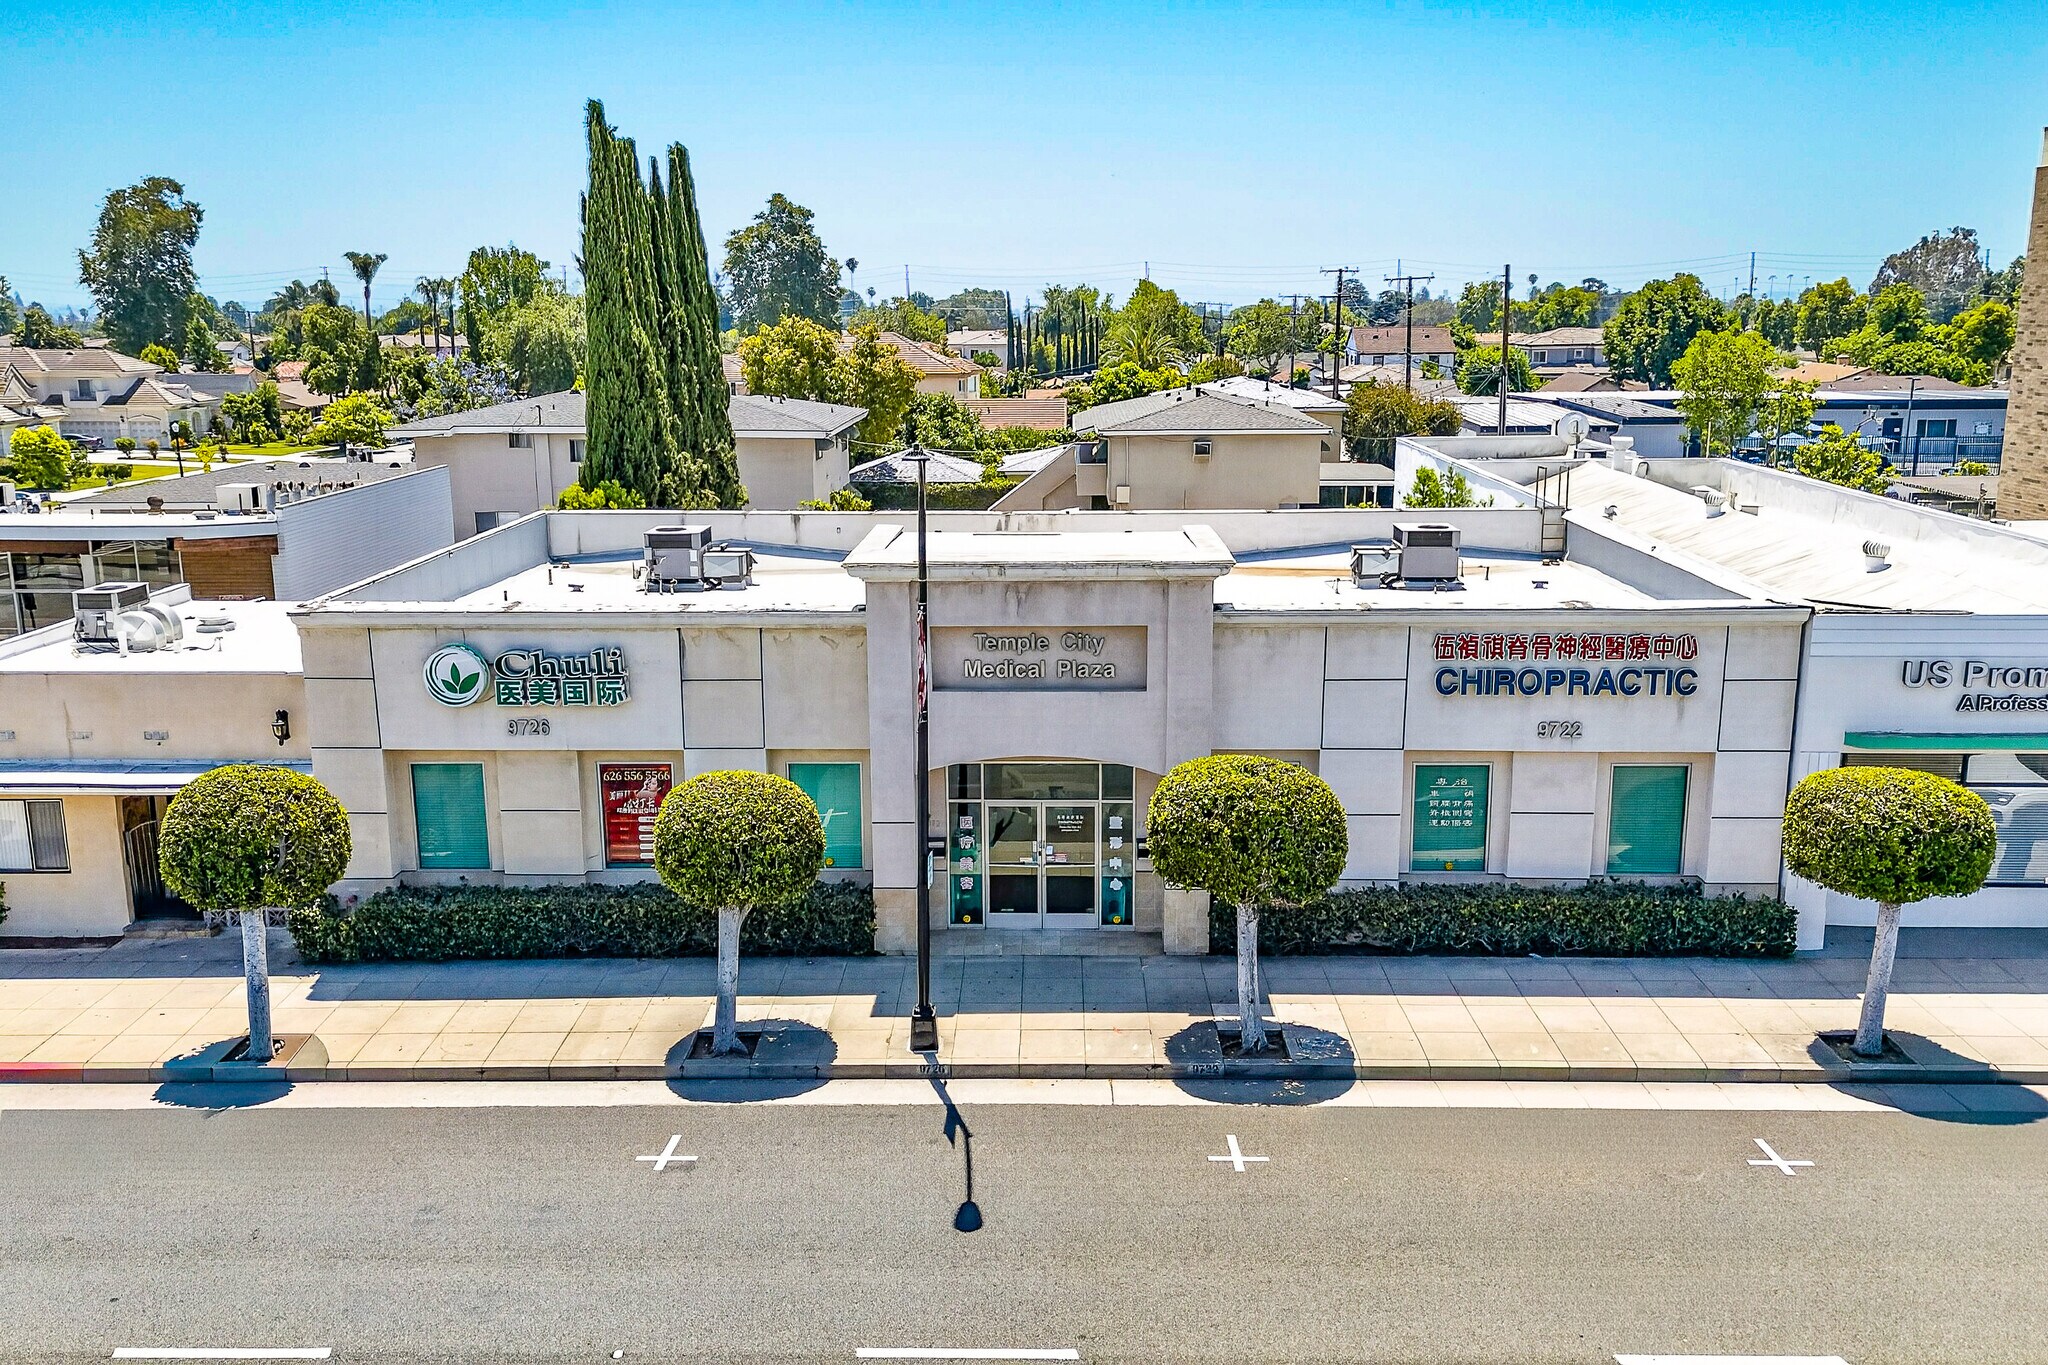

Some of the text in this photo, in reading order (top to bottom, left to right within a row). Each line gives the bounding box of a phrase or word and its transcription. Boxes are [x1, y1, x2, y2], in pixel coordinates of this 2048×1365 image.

[973, 633, 1105, 656] Temple City
[494, 647, 625, 679] Chuli
[963, 659, 1116, 678] Medical Plaza
[1434, 667, 1699, 696] CHIROPRACTIC
[1902, 660, 1953, 689] US
[494, 679, 629, 706] 医美国际
[1956, 694, 1975, 712] A
[507, 718, 551, 736] 9726
[1537, 721, 1582, 739] 9722
[603, 771, 622, 781] 626
[624, 771, 643, 781] 556
